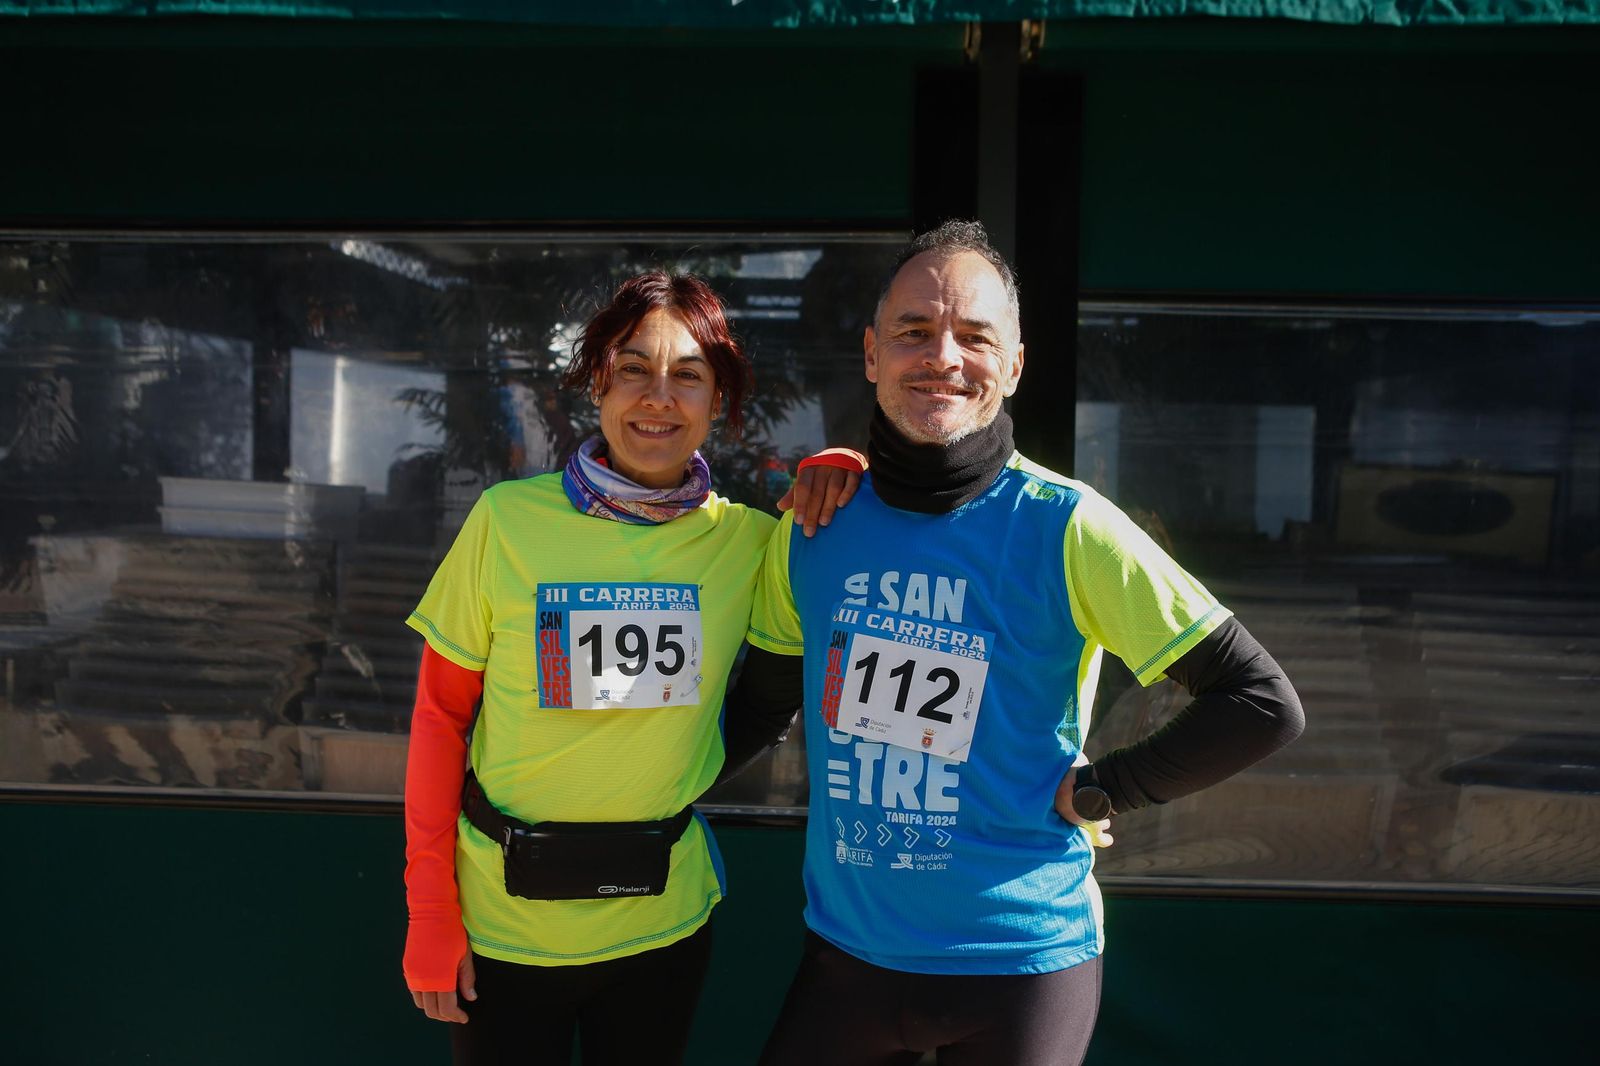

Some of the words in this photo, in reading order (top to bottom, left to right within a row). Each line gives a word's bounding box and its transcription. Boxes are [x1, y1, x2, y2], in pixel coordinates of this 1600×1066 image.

[544, 588, 568, 602] III
[579, 587, 695, 603] CARRERA
[612, 602, 660, 610] TARIFA
[669, 602, 696, 611] 2024
[877, 570, 967, 624] SAN
[540, 611, 562, 630] SAN
[839, 608, 859, 624] III
[866, 613, 986, 652] CARRERA
[540, 630, 564, 656] SIL
[578, 623, 686, 677] 195
[830, 630, 849, 650] SAN
[893, 633, 941, 651] TARIFA
[950, 646, 985, 661] 2024
[541, 654, 571, 682] VES
[827, 649, 843, 675] SIL
[543, 681, 572, 707] TRE
[854, 651, 961, 725] 112
[854, 742, 960, 812] TRE
[885, 811, 923, 825] TARIFA
[926, 814, 957, 827] 2024
[914, 852, 953, 863] Diputación
[926, 862, 948, 871] Cádiz
